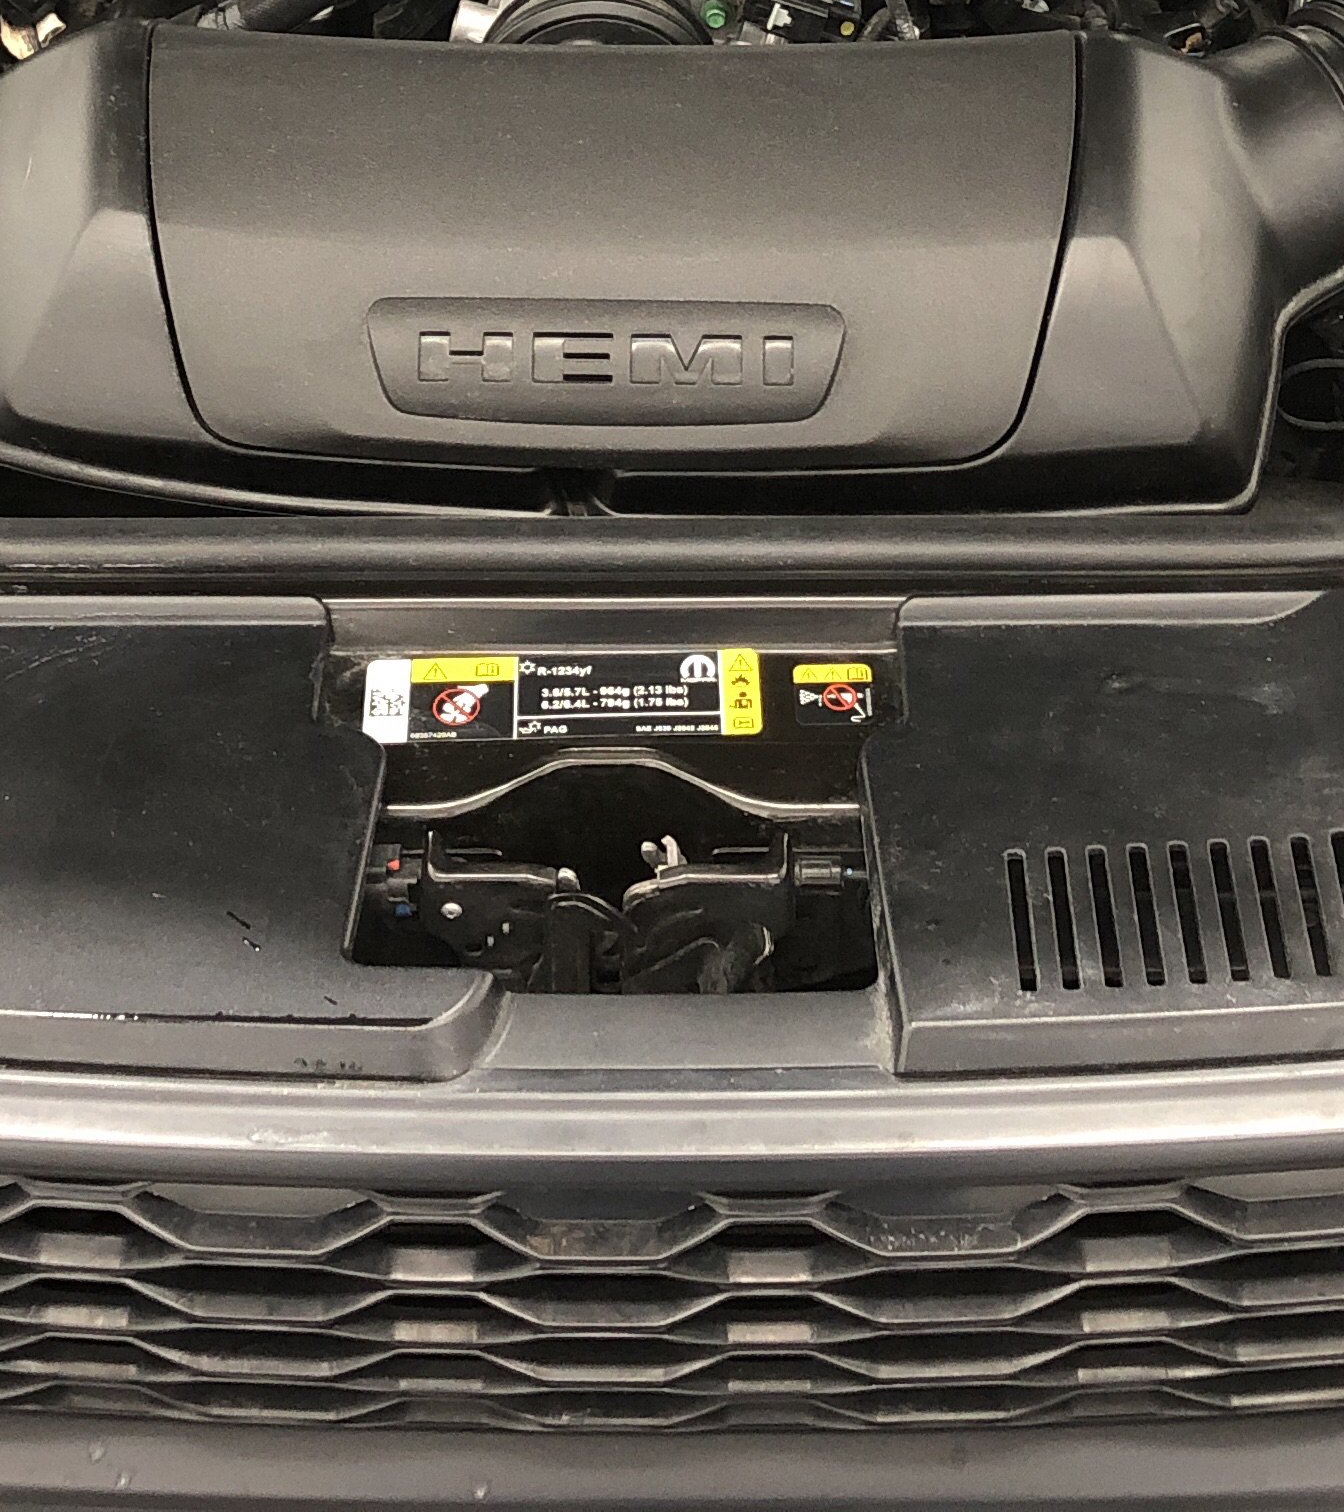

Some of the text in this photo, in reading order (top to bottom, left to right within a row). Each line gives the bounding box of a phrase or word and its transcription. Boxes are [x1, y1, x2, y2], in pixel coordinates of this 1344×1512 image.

[417, 330, 795, 387] HEMI
[536, 665, 593, 676] R-1234yf
[543, 724, 568, 735] PAG
